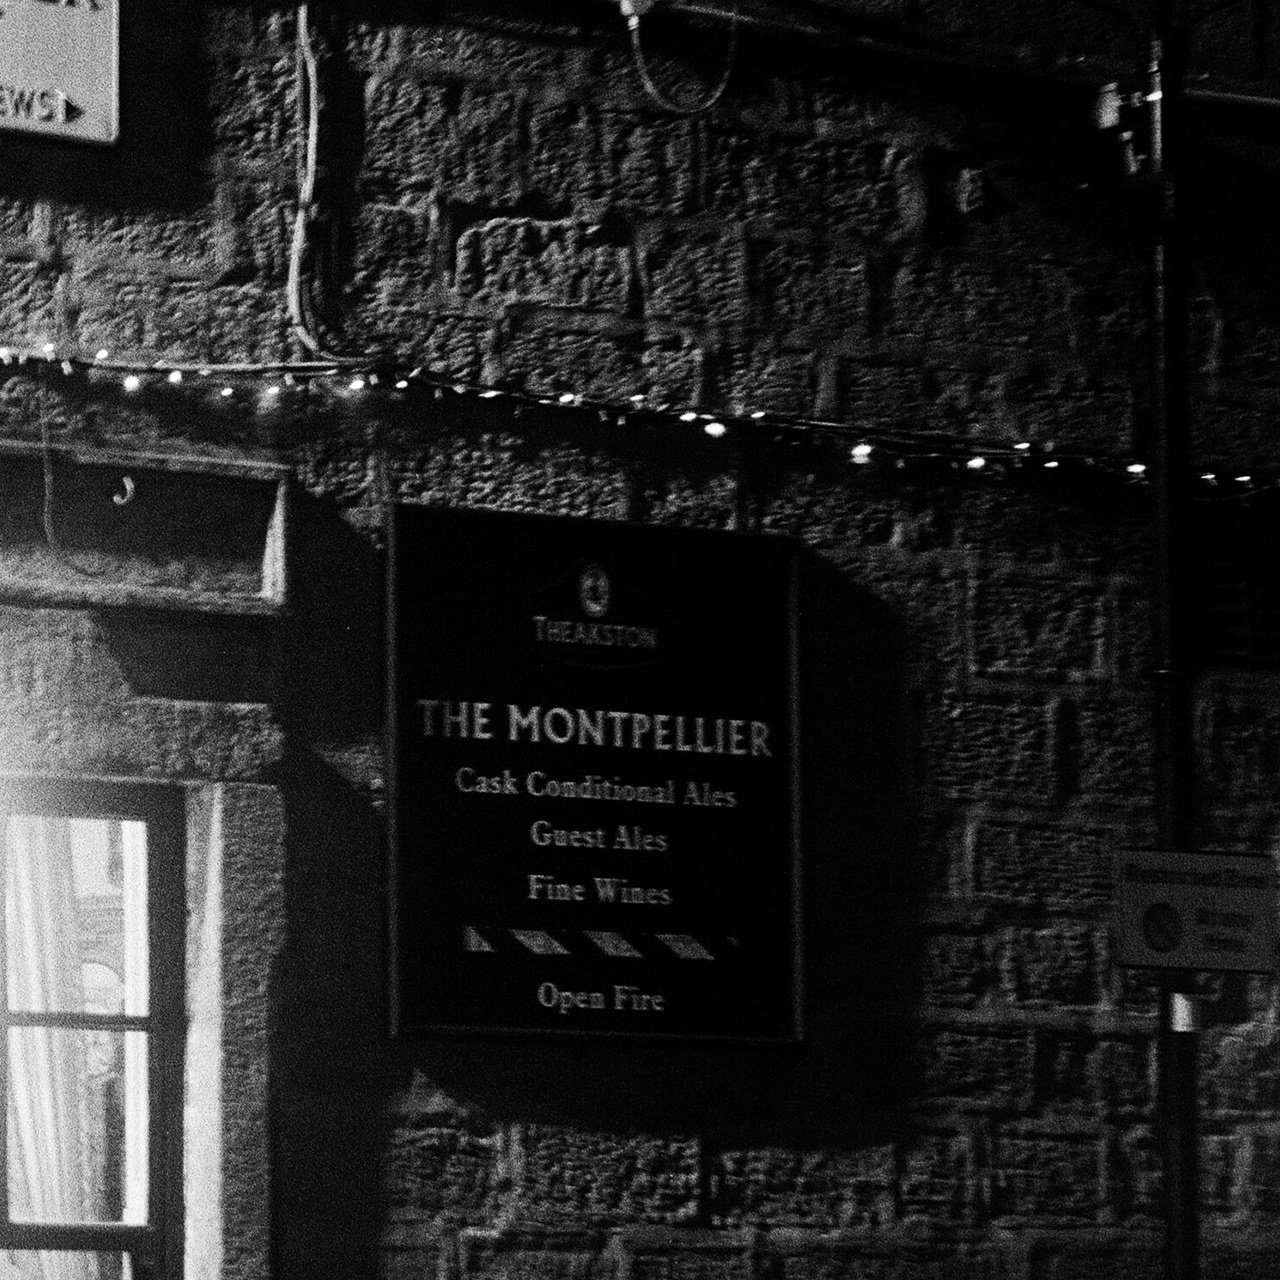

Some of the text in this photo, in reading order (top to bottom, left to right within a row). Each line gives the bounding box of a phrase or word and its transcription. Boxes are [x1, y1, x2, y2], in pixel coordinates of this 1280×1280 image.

[417, 699, 773, 758] THE MONTPELLIER
[455, 767, 738, 808] Cask Conditional Ales
[530, 820, 669, 852] Guest Ales
[527, 874, 674, 905] Fine Wines
[538, 982, 666, 1014] Open Fire
